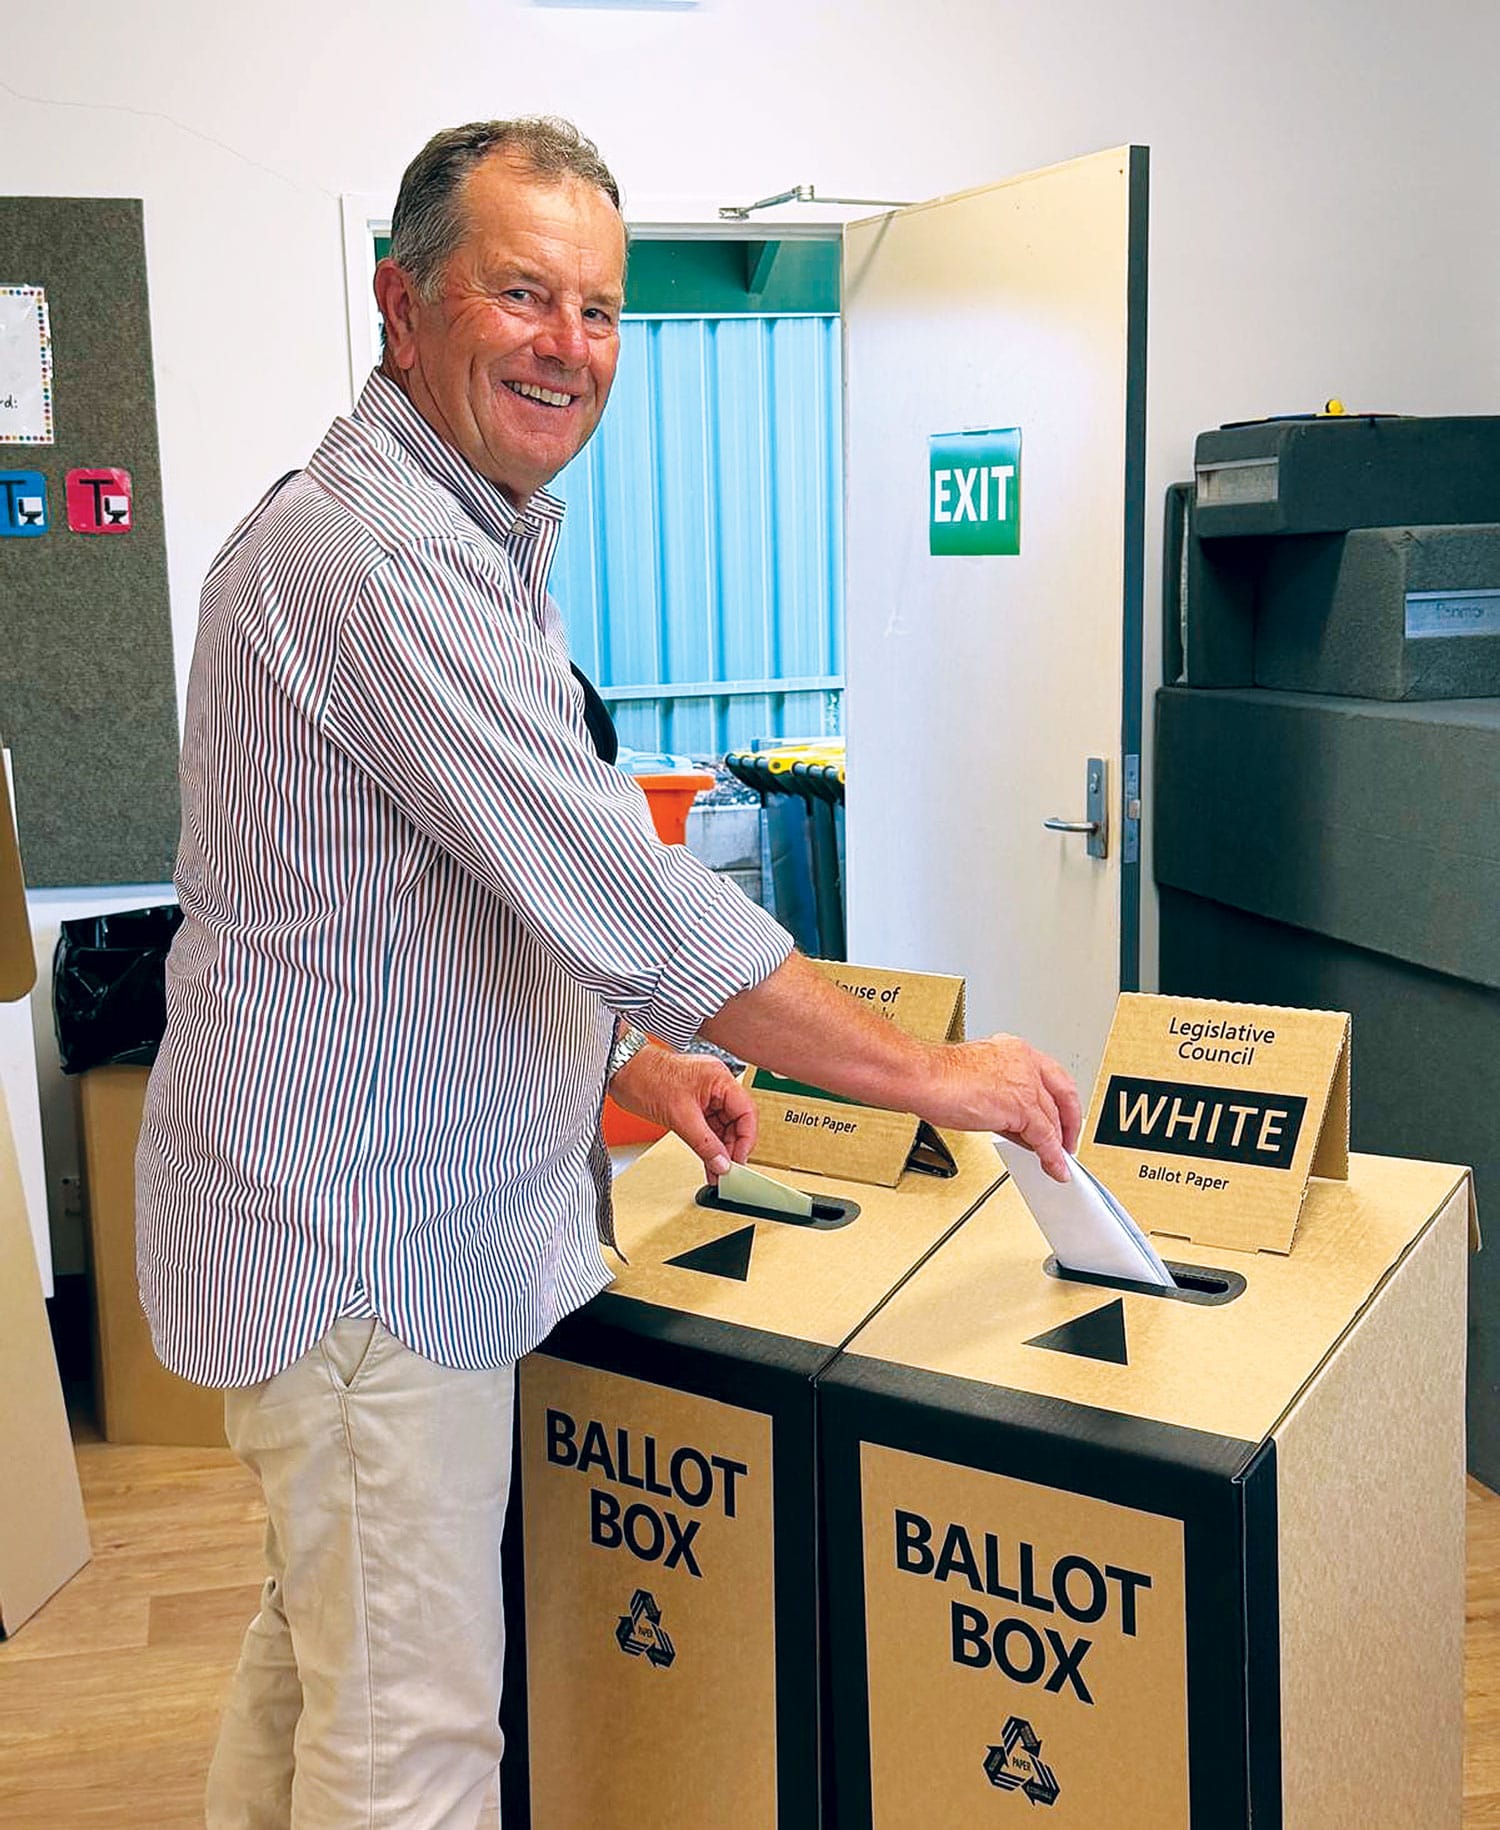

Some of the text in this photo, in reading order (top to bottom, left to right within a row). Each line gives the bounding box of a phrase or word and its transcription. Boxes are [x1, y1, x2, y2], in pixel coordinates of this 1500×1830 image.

[79, 478, 114, 527] T
[934, 465, 1014, 522] EXIT
[880, 986, 901, 1003] of
[1169, 1017, 1275, 1043] Legislative
[1178, 1041, 1255, 1065] Council
[784, 1109, 857, 1134] Ballot Paper
[1118, 1090, 1288, 1152] WHITE
[1139, 1164, 1230, 1191] Ballot Paper
[546, 1407, 748, 1519] BALLOT
[590, 1488, 703, 1578] BOX
[895, 1508, 1153, 1637] BALLOT
[951, 1600, 1095, 1706] BOX
